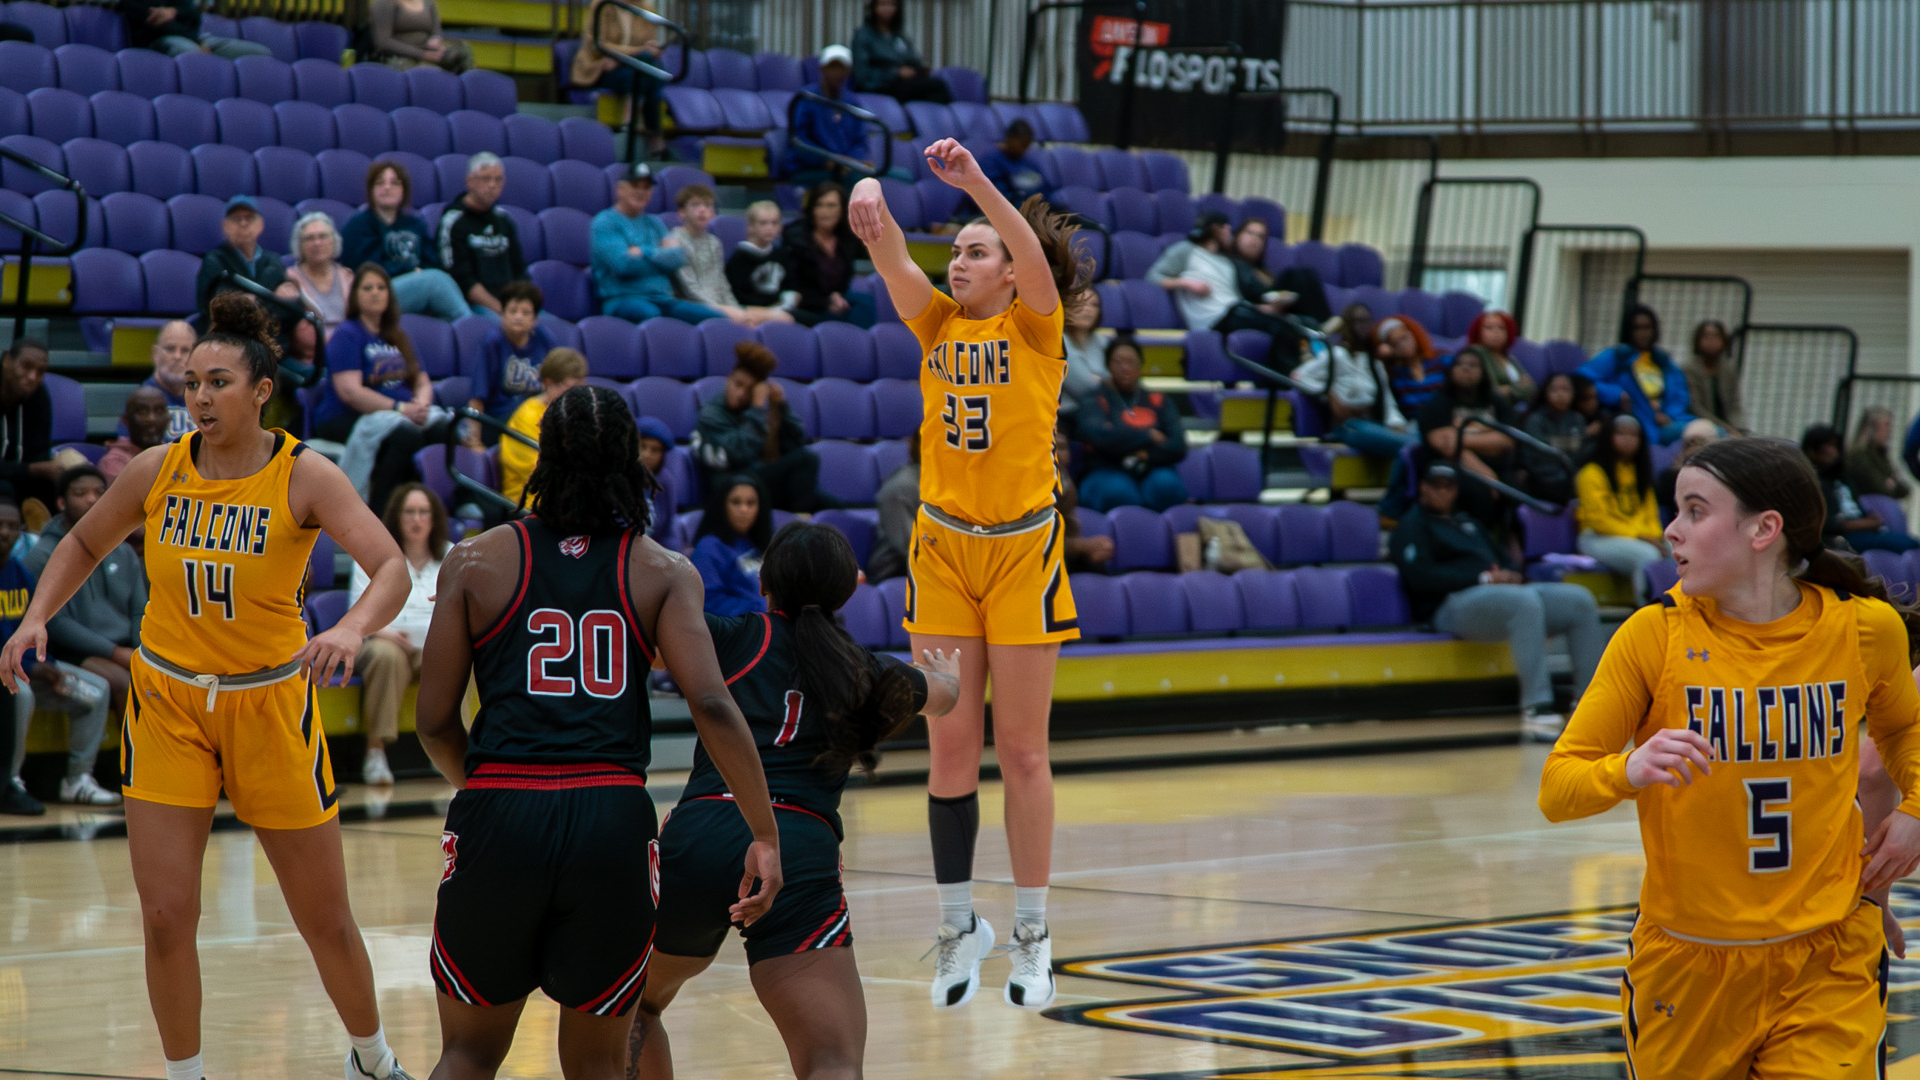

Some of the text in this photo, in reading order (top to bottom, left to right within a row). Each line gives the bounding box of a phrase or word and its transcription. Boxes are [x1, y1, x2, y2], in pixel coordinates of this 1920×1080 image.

[941, 392, 992, 453] 33
[158, 495, 271, 556] FALCONS
[182, 558, 235, 621] 14
[528, 608, 626, 699] 20
[774, 689, 804, 747] 1
[1685, 680, 1847, 763] FALCONS
[1742, 777, 1792, 873] 5
